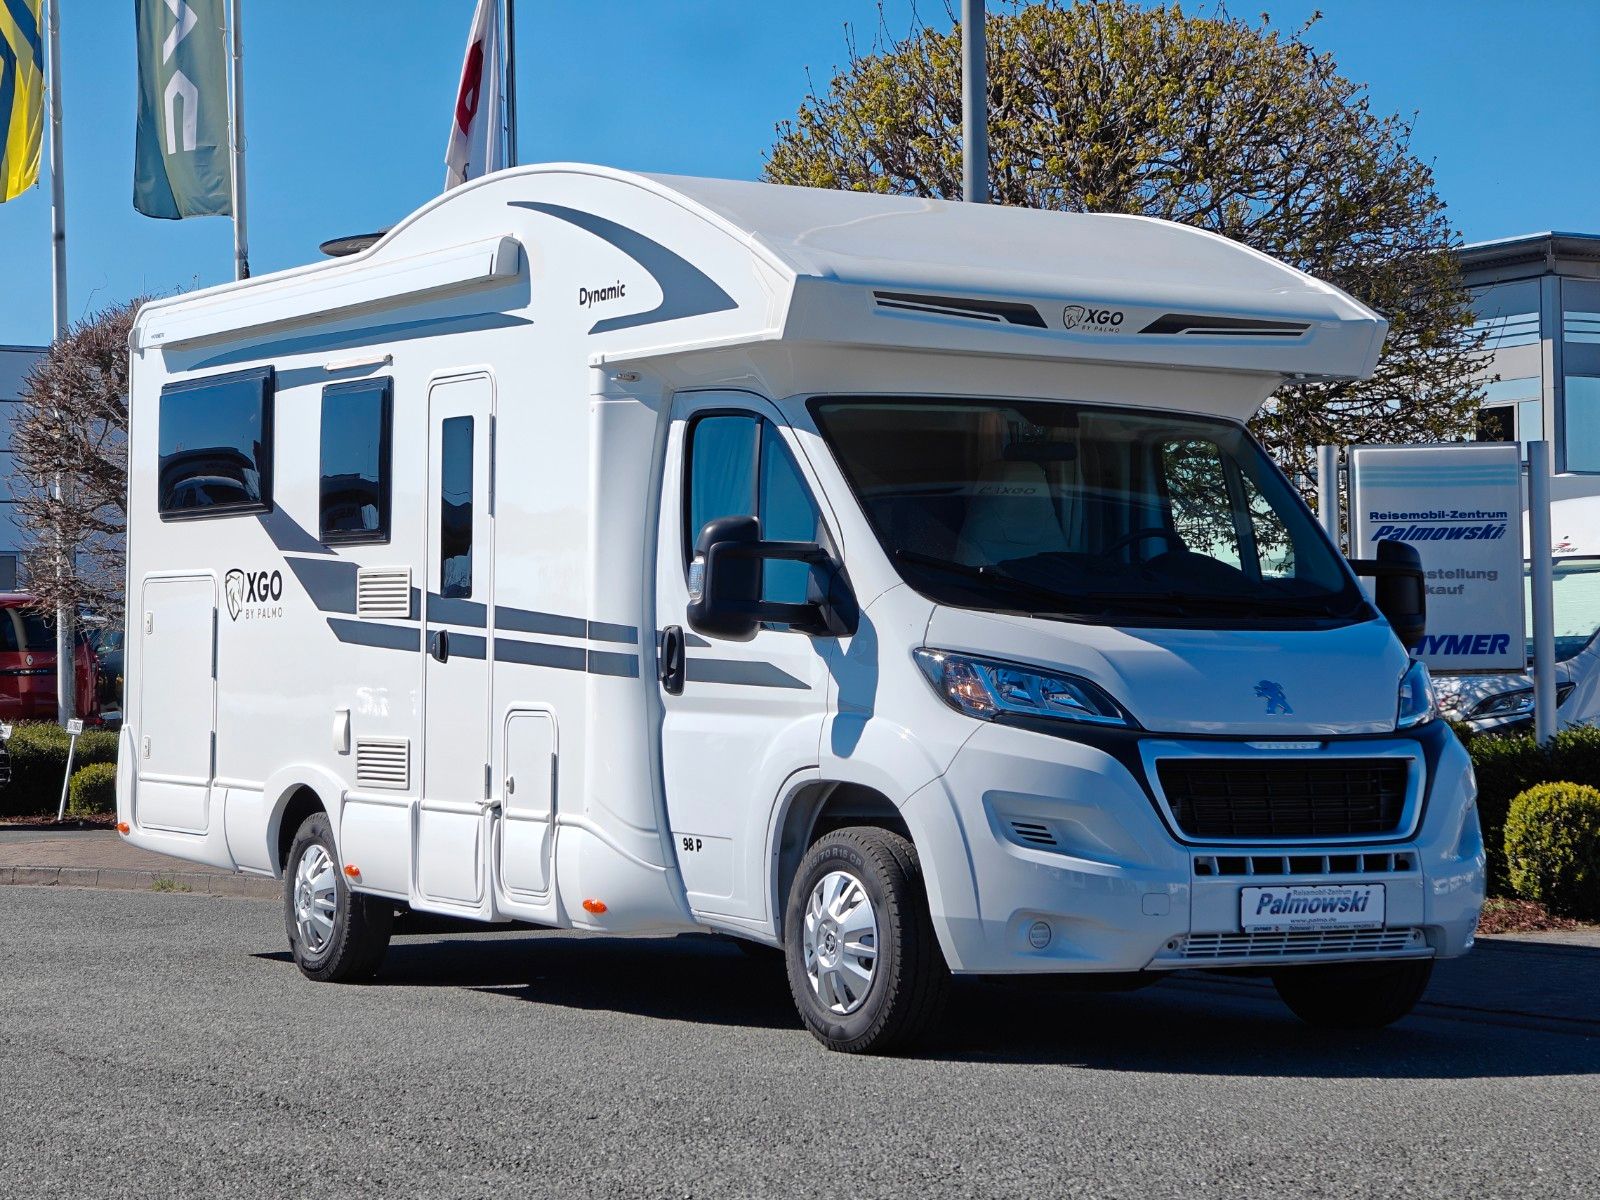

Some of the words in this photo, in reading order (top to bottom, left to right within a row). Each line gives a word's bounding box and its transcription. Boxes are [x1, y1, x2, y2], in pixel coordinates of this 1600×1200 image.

[579, 280, 626, 309] Dynamic
[1084, 309, 1124, 326] XGO
[1369, 510, 1508, 520] Reisemobil-Zentrum
[1371, 523, 1507, 542] Palmowski
[246, 569, 283, 603] XGO
[246, 608, 255, 620] BY
[258, 607, 283, 619] PALMO
[683, 837, 694, 851] 98
[696, 838, 703, 853] P
[1256, 890, 1371, 915] Palmowski
